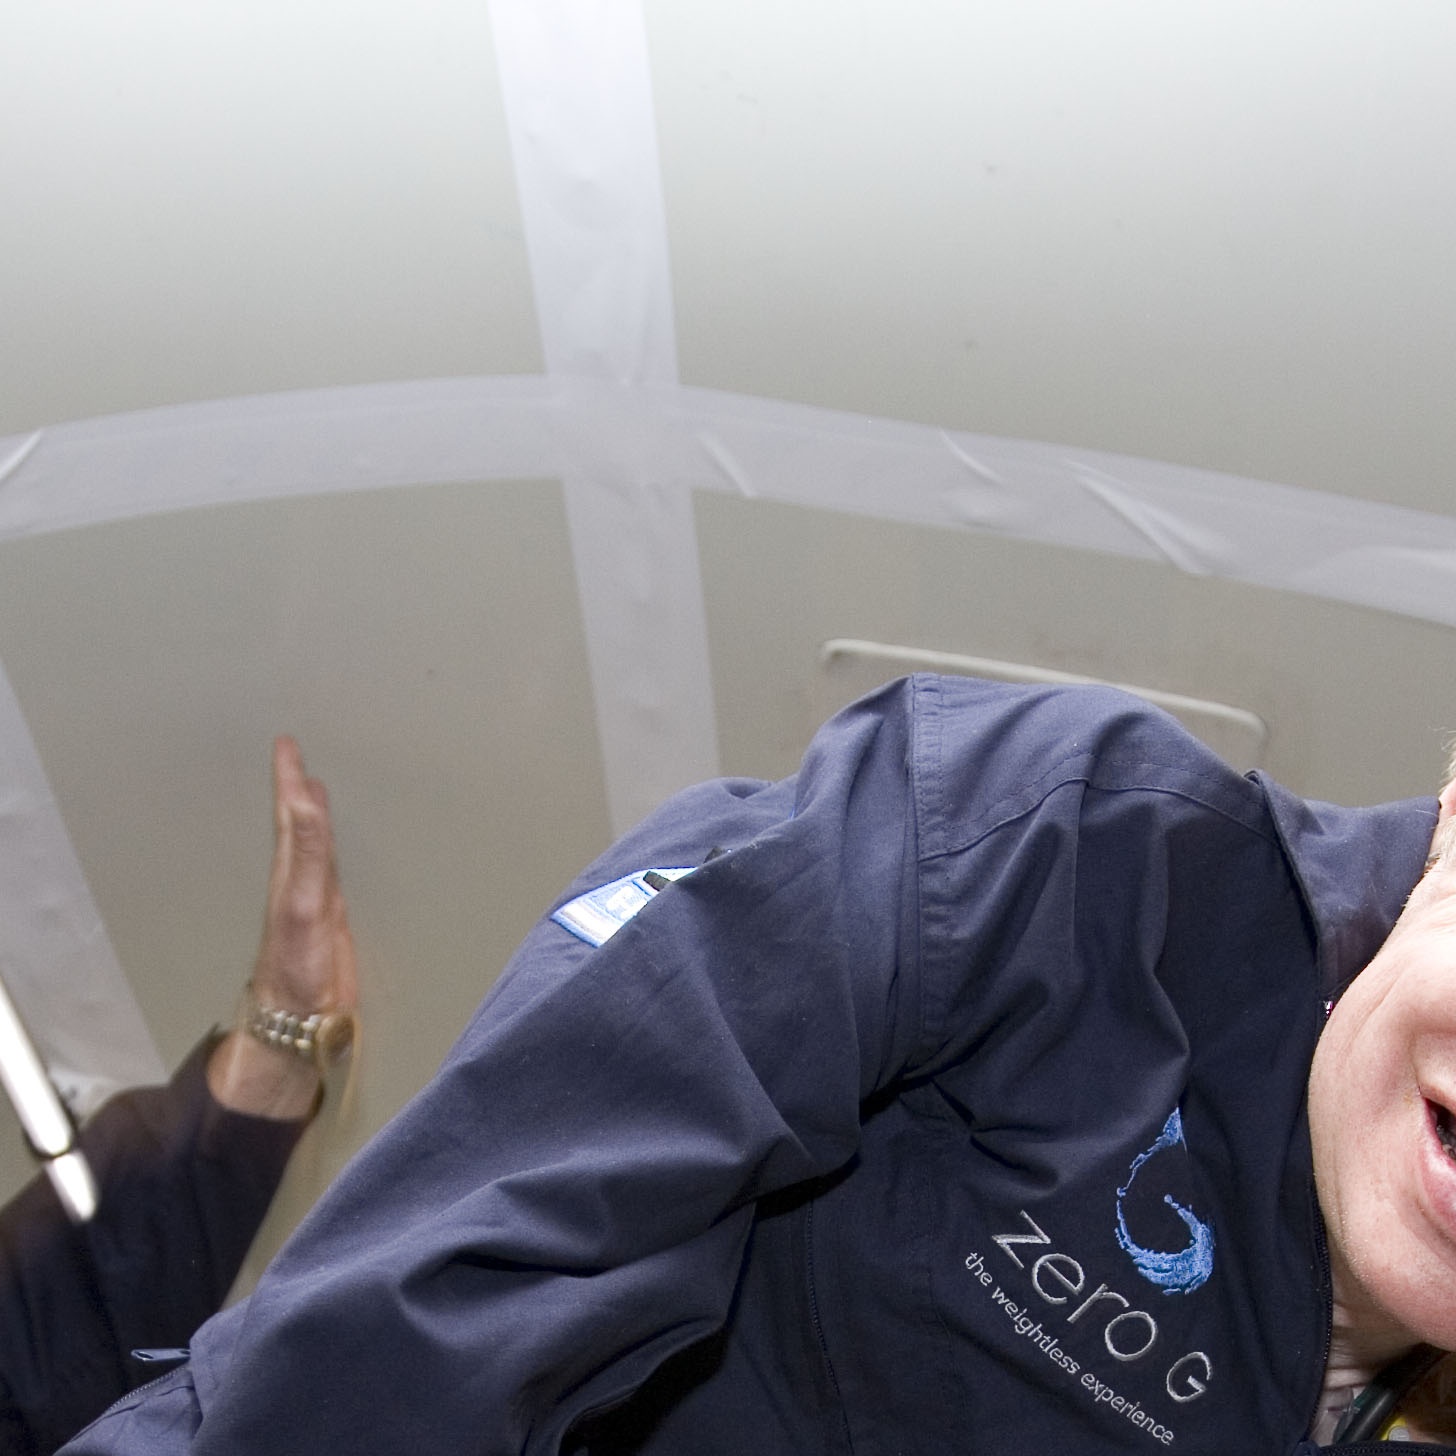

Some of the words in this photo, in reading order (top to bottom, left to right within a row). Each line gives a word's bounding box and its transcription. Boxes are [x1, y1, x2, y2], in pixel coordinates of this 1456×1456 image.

[965, 1252, 993, 1287] the
[991, 1287, 1081, 1376] weightless
[1081, 1372, 1175, 1445] experience
[992, 1210, 1158, 1361] zero
[1166, 1351, 1213, 1403] G
